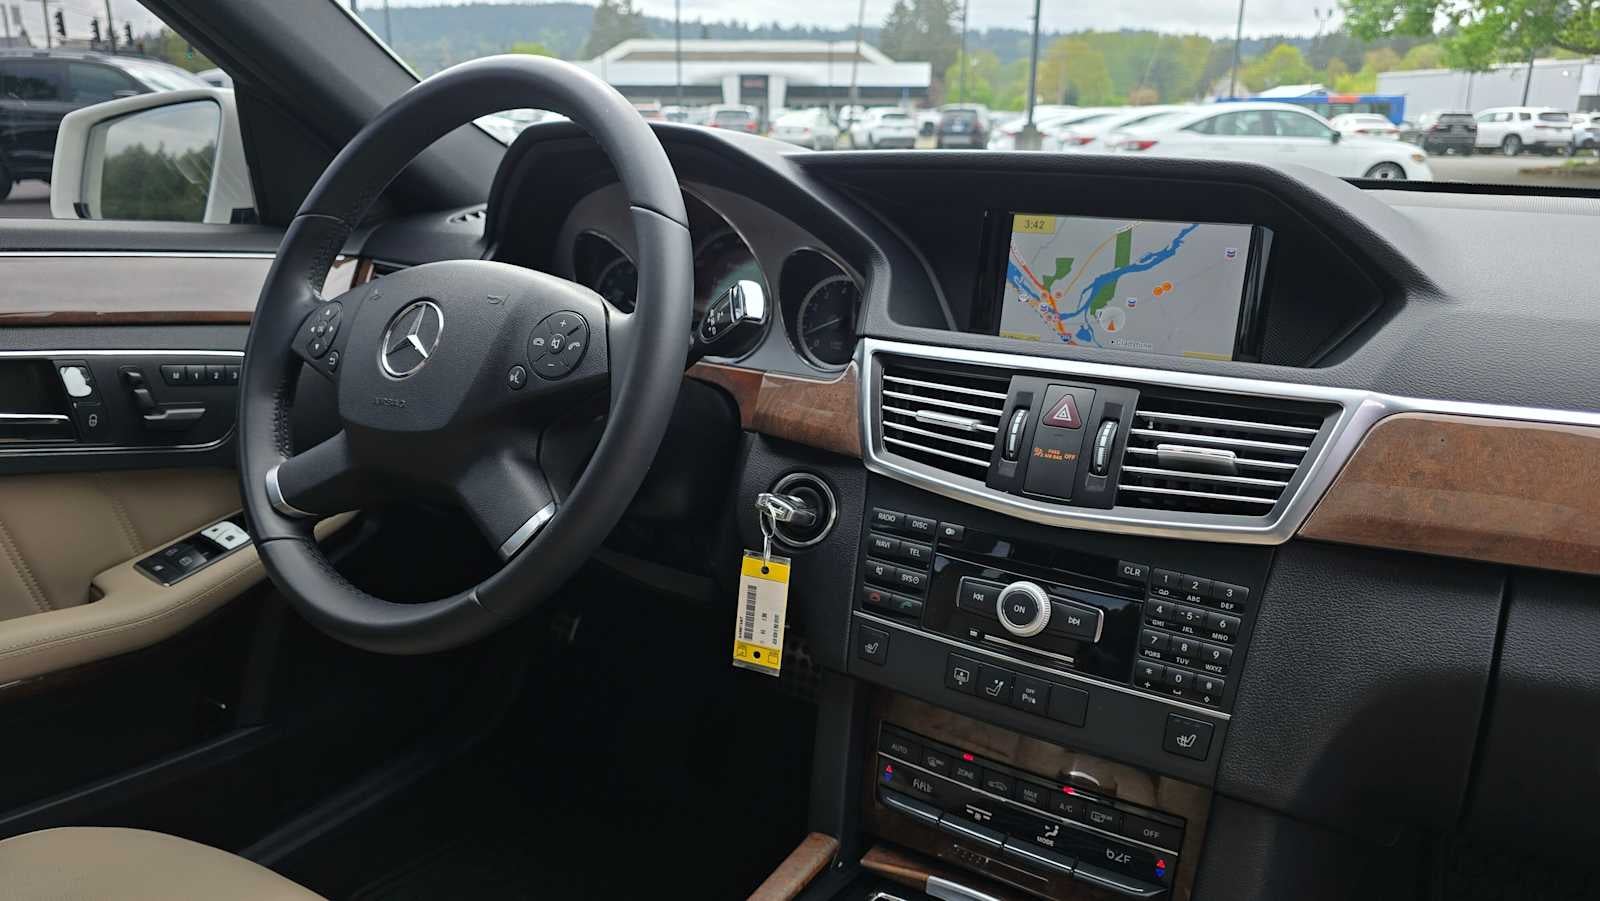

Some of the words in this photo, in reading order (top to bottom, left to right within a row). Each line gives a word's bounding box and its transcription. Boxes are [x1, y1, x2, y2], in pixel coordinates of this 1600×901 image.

[1024, 219, 1046, 230] 3:42
[213, 372, 219, 380] 2
[232, 371, 238, 380] 3
[878, 512, 896, 523] RADIO
[912, 519, 928, 530] DISC
[875, 538, 891, 549] NAVI
[909, 547, 921, 558] TEL
[1123, 566, 1141, 577] CLR
[901, 573, 913, 583] SYS
[1163, 575, 1168, 583] 1
[1192, 581, 1199, 590] 2
[1226, 589, 1233, 597] 3
[1186, 595, 1200, 603] ABC
[1013, 604, 1026, 614] ON
[1156, 605, 1163, 614] 4
[1220, 602, 1234, 610] DEF
[1152, 619, 1165, 627] GHI
[1219, 619, 1226, 628] 6
[1182, 626, 1194, 634] JKL
[1151, 636, 1158, 645] 7
[1212, 632, 1228, 641] MNO
[1181, 643, 1188, 651] 8
[1144, 650, 1161, 659] PQRS
[1213, 650, 1220, 659] 9
[1176, 656, 1190, 665] TUV
[1205, 664, 1222, 673] WXYZ
[1175, 674, 1182, 683] 0
[891, 744, 908, 754] AUTO
[957, 767, 974, 779] ZONE
[1059, 803, 1073, 813] A/C
[1143, 828, 1160, 839] OFF
[1036, 836, 1055, 847] MODE
